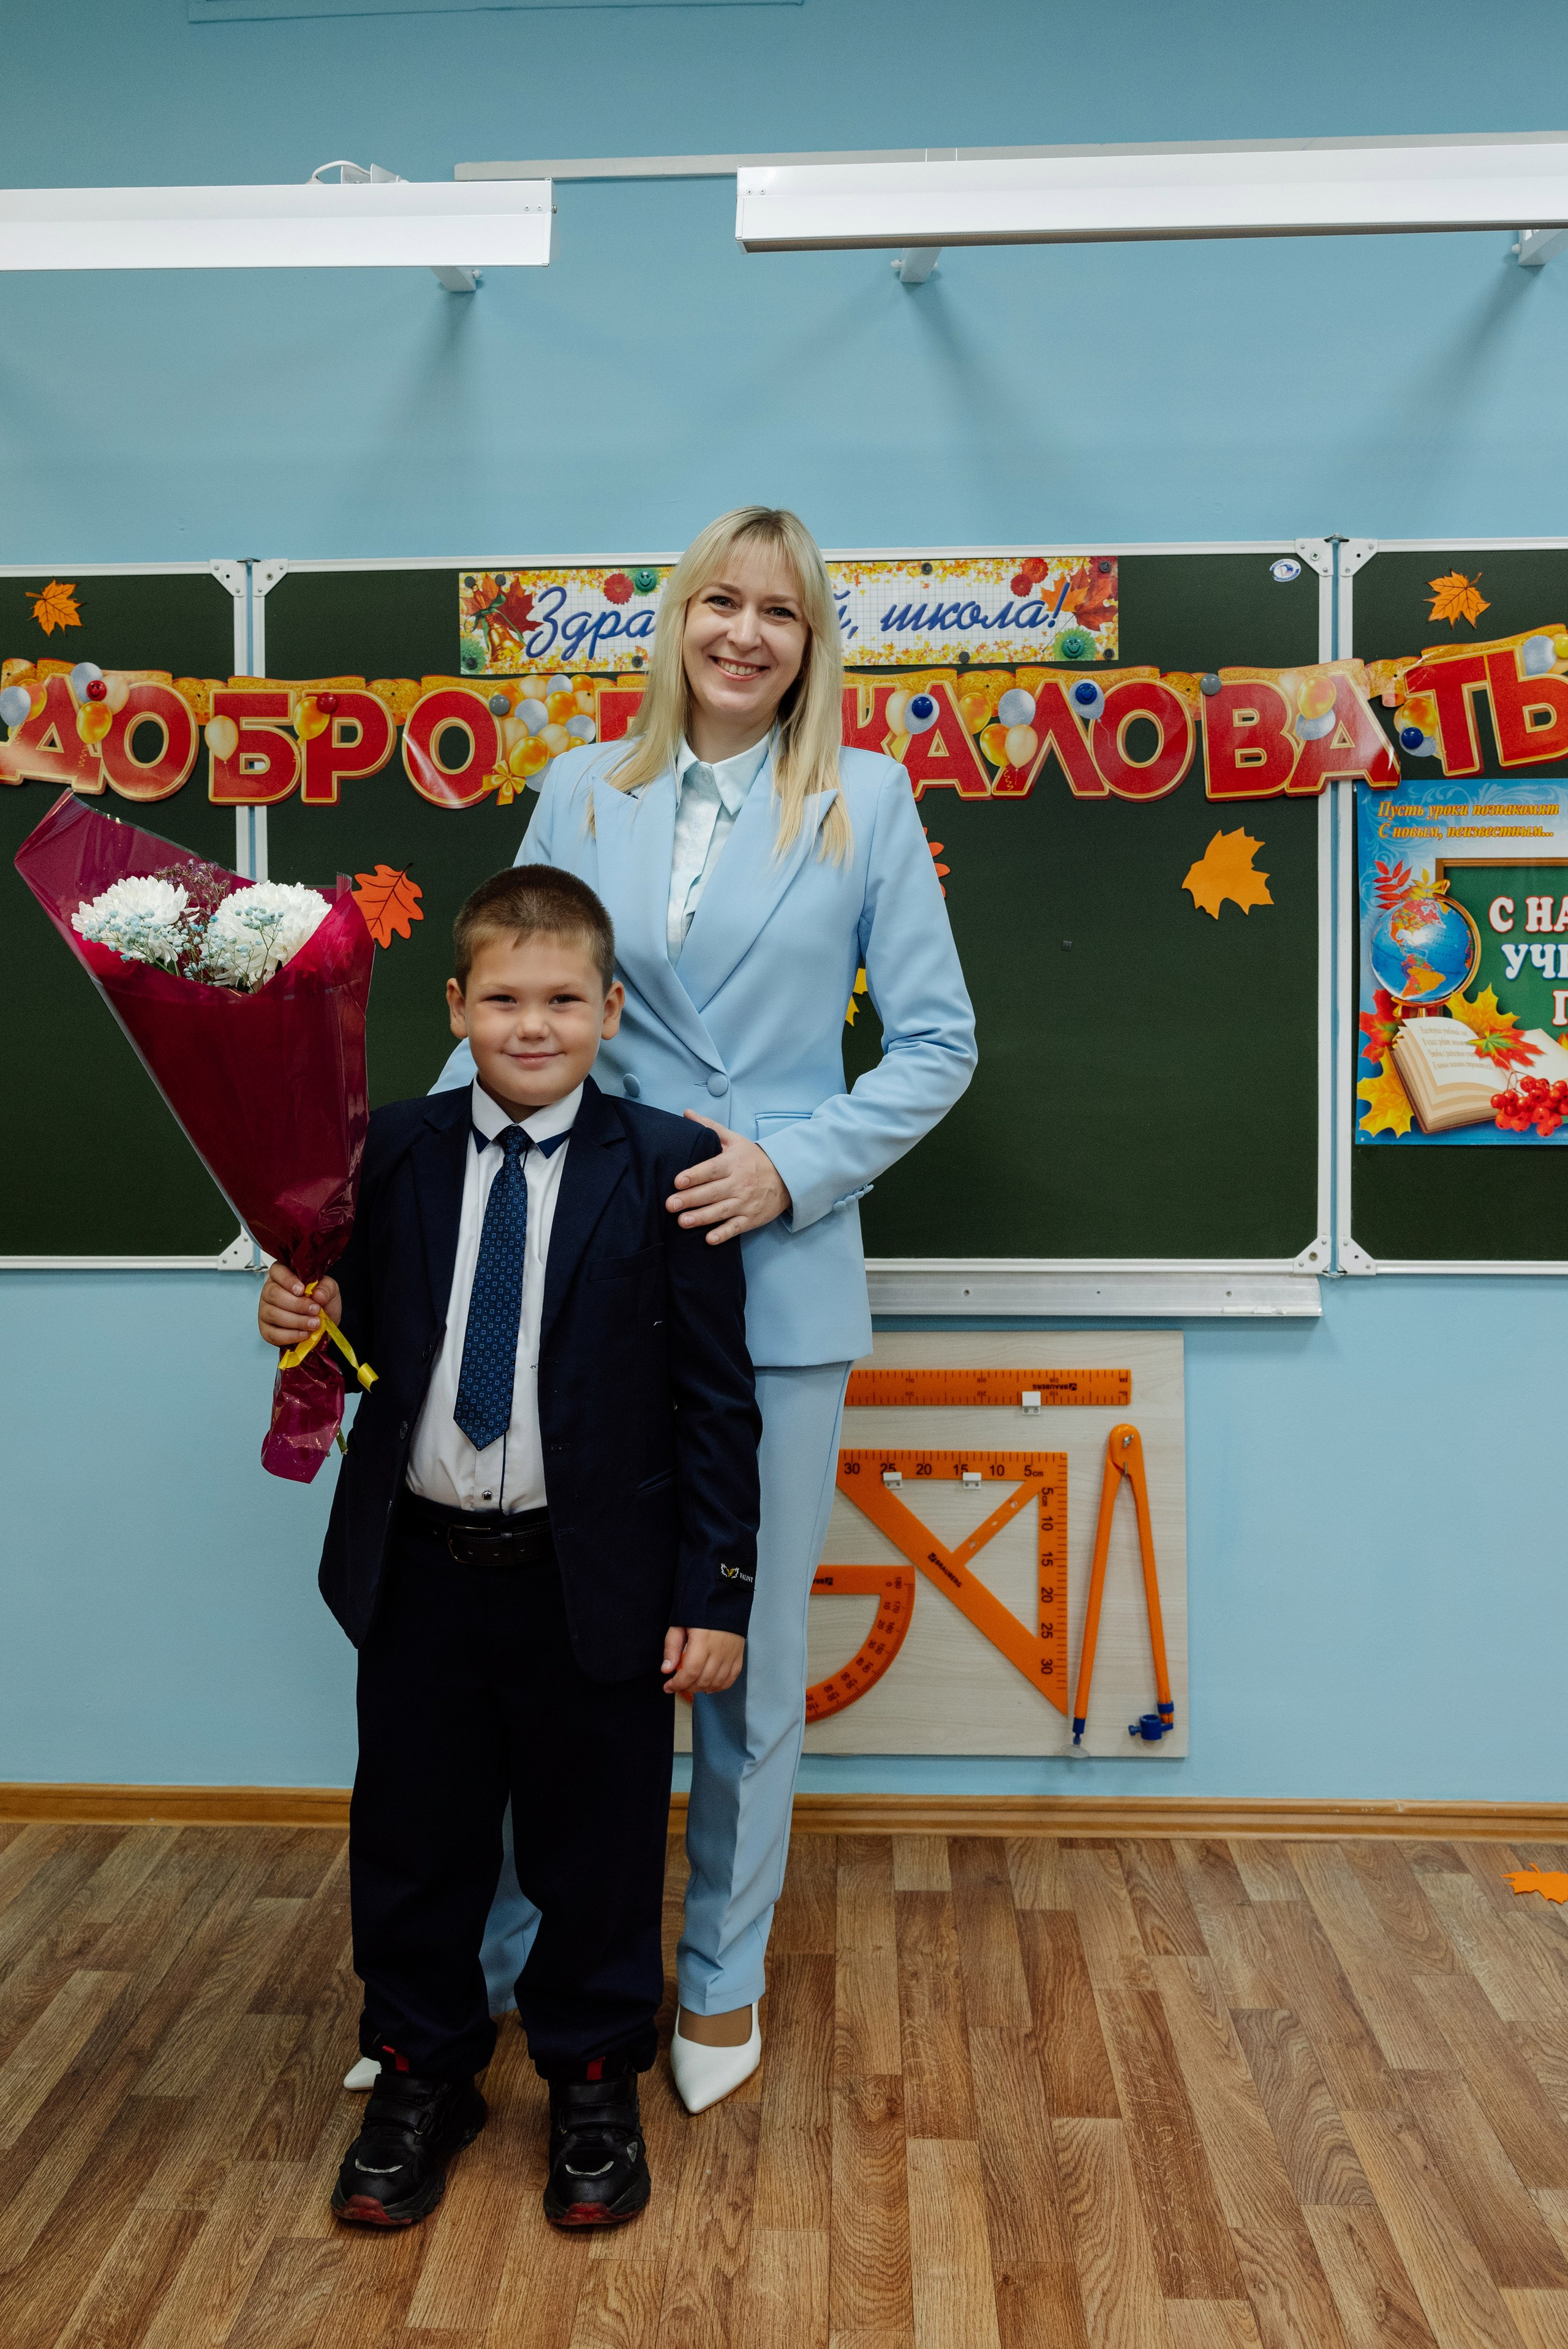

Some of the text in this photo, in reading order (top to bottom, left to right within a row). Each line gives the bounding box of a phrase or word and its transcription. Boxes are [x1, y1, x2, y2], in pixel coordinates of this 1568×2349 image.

[880, 581, 1071, 632] школа!
[0, 671, 502, 809] ДОБРО
[1378, 801, 1559, 820] Пусть уроки познакомят
[1379, 822, 1555, 841] С новым, неизвестным...
[1488, 895, 1515, 933] С
[844, 1462, 860, 1475] 30
[880, 1463, 896, 1473] 25
[916, 1464, 932, 1475] 20
[953, 1464, 968, 1475] 15
[990, 1464, 1005, 1476] 10
[1041, 1516, 1054, 1531] 10
[1041, 1552, 1054, 1567] 15
[935, 1559, 963, 1588] BRAUBERG
[1041, 1587, 1054, 1603] 20
[1041, 1623, 1054, 1639] 25
[1041, 1659, 1054, 1675] 30
